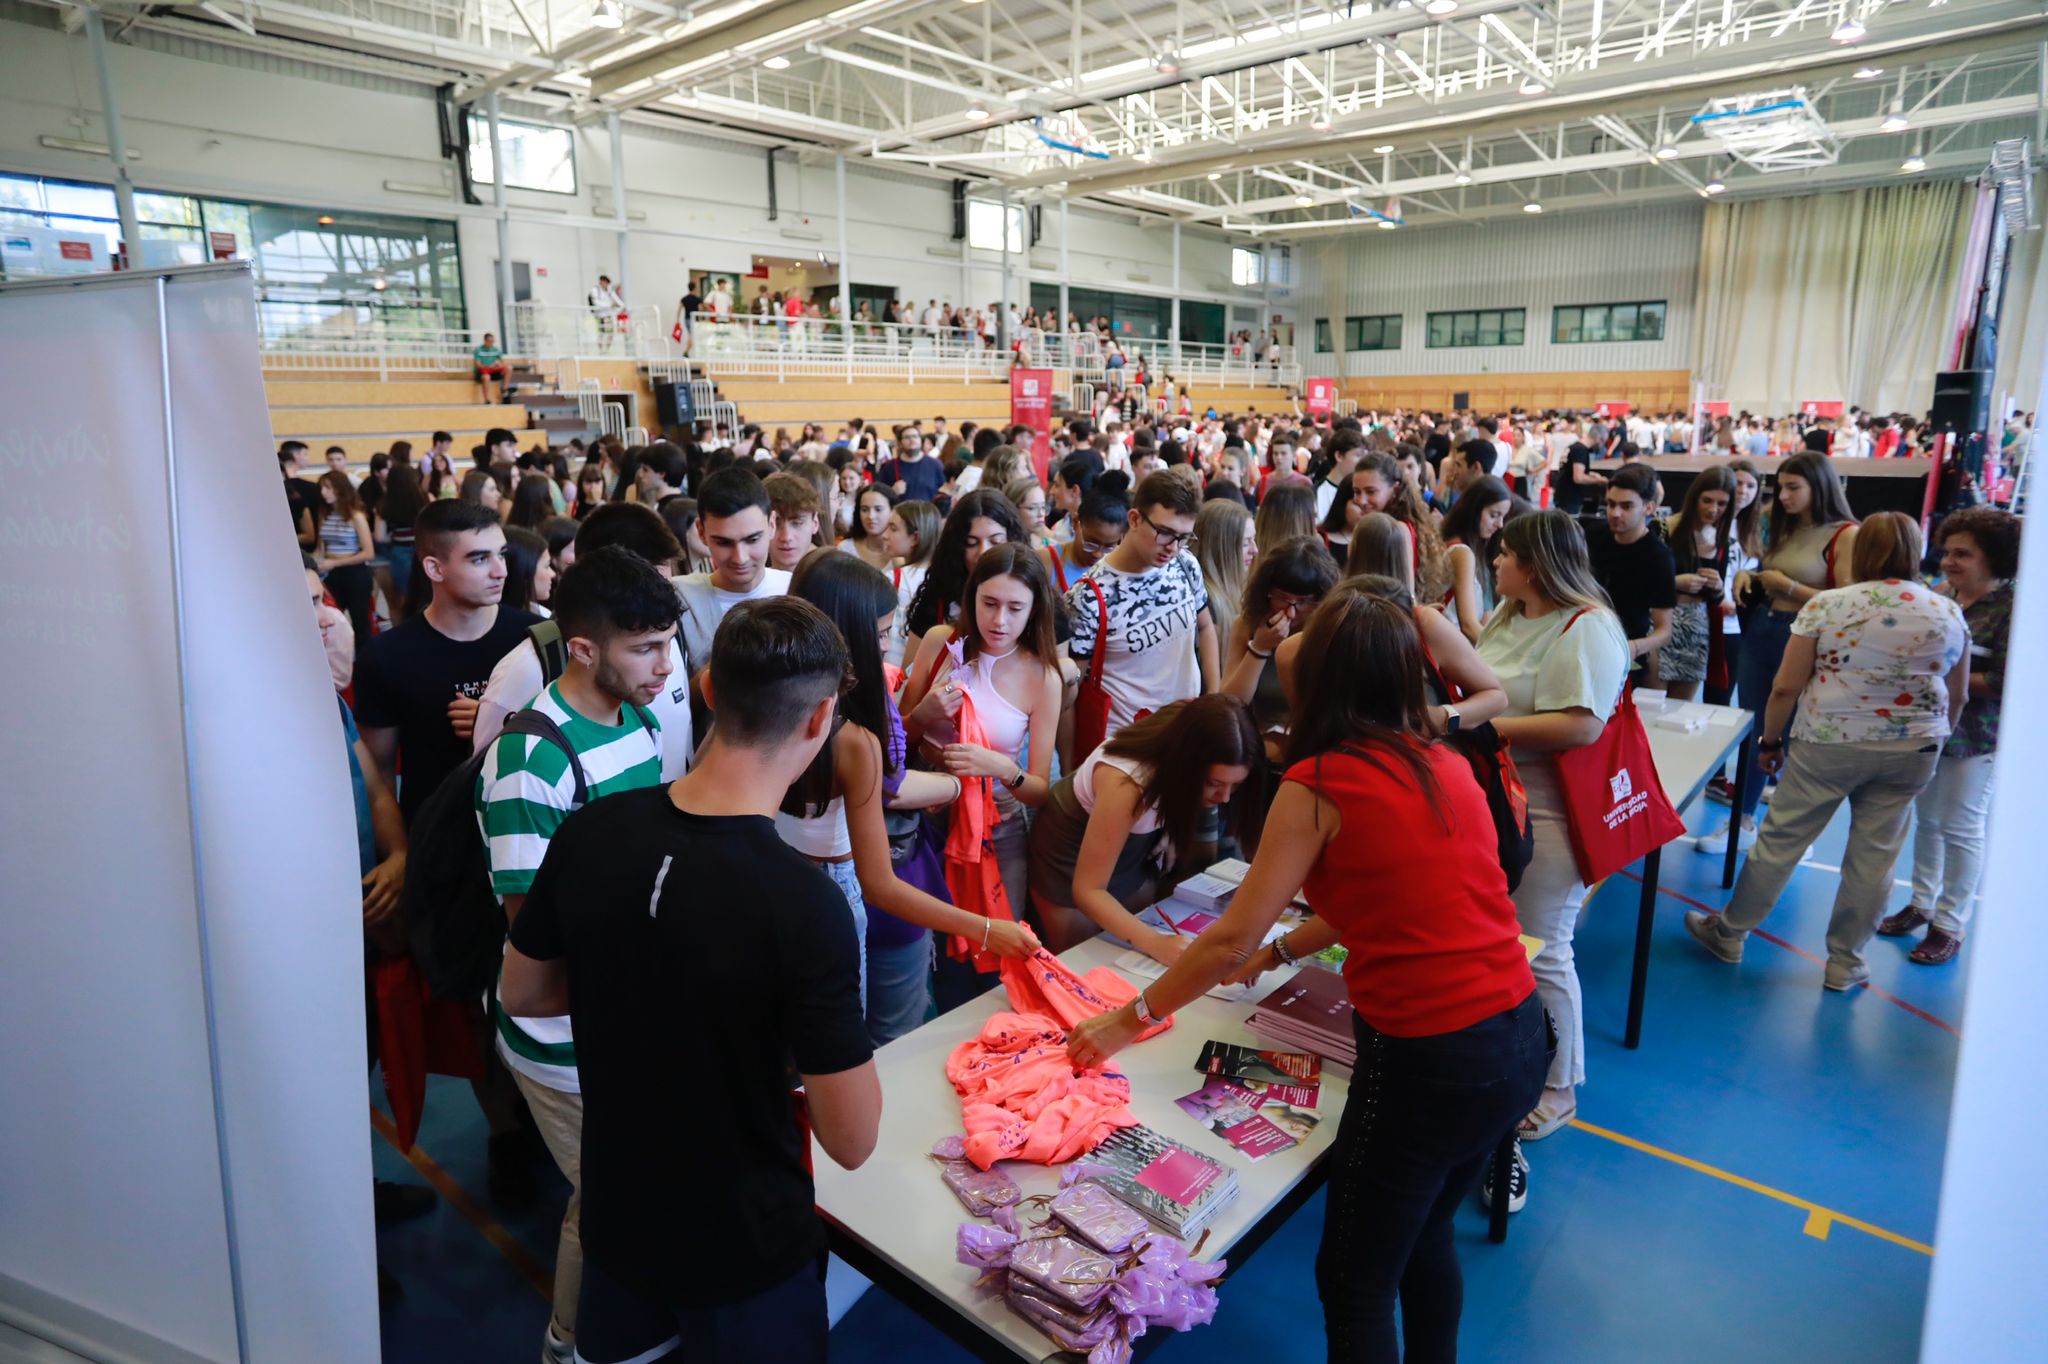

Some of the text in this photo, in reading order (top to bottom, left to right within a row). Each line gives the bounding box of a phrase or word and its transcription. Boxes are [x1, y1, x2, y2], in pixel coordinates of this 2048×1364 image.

[454, 680, 489, 690] TOMM
[1609, 819, 1618, 829] DE
[1618, 812, 1628, 823] LA
